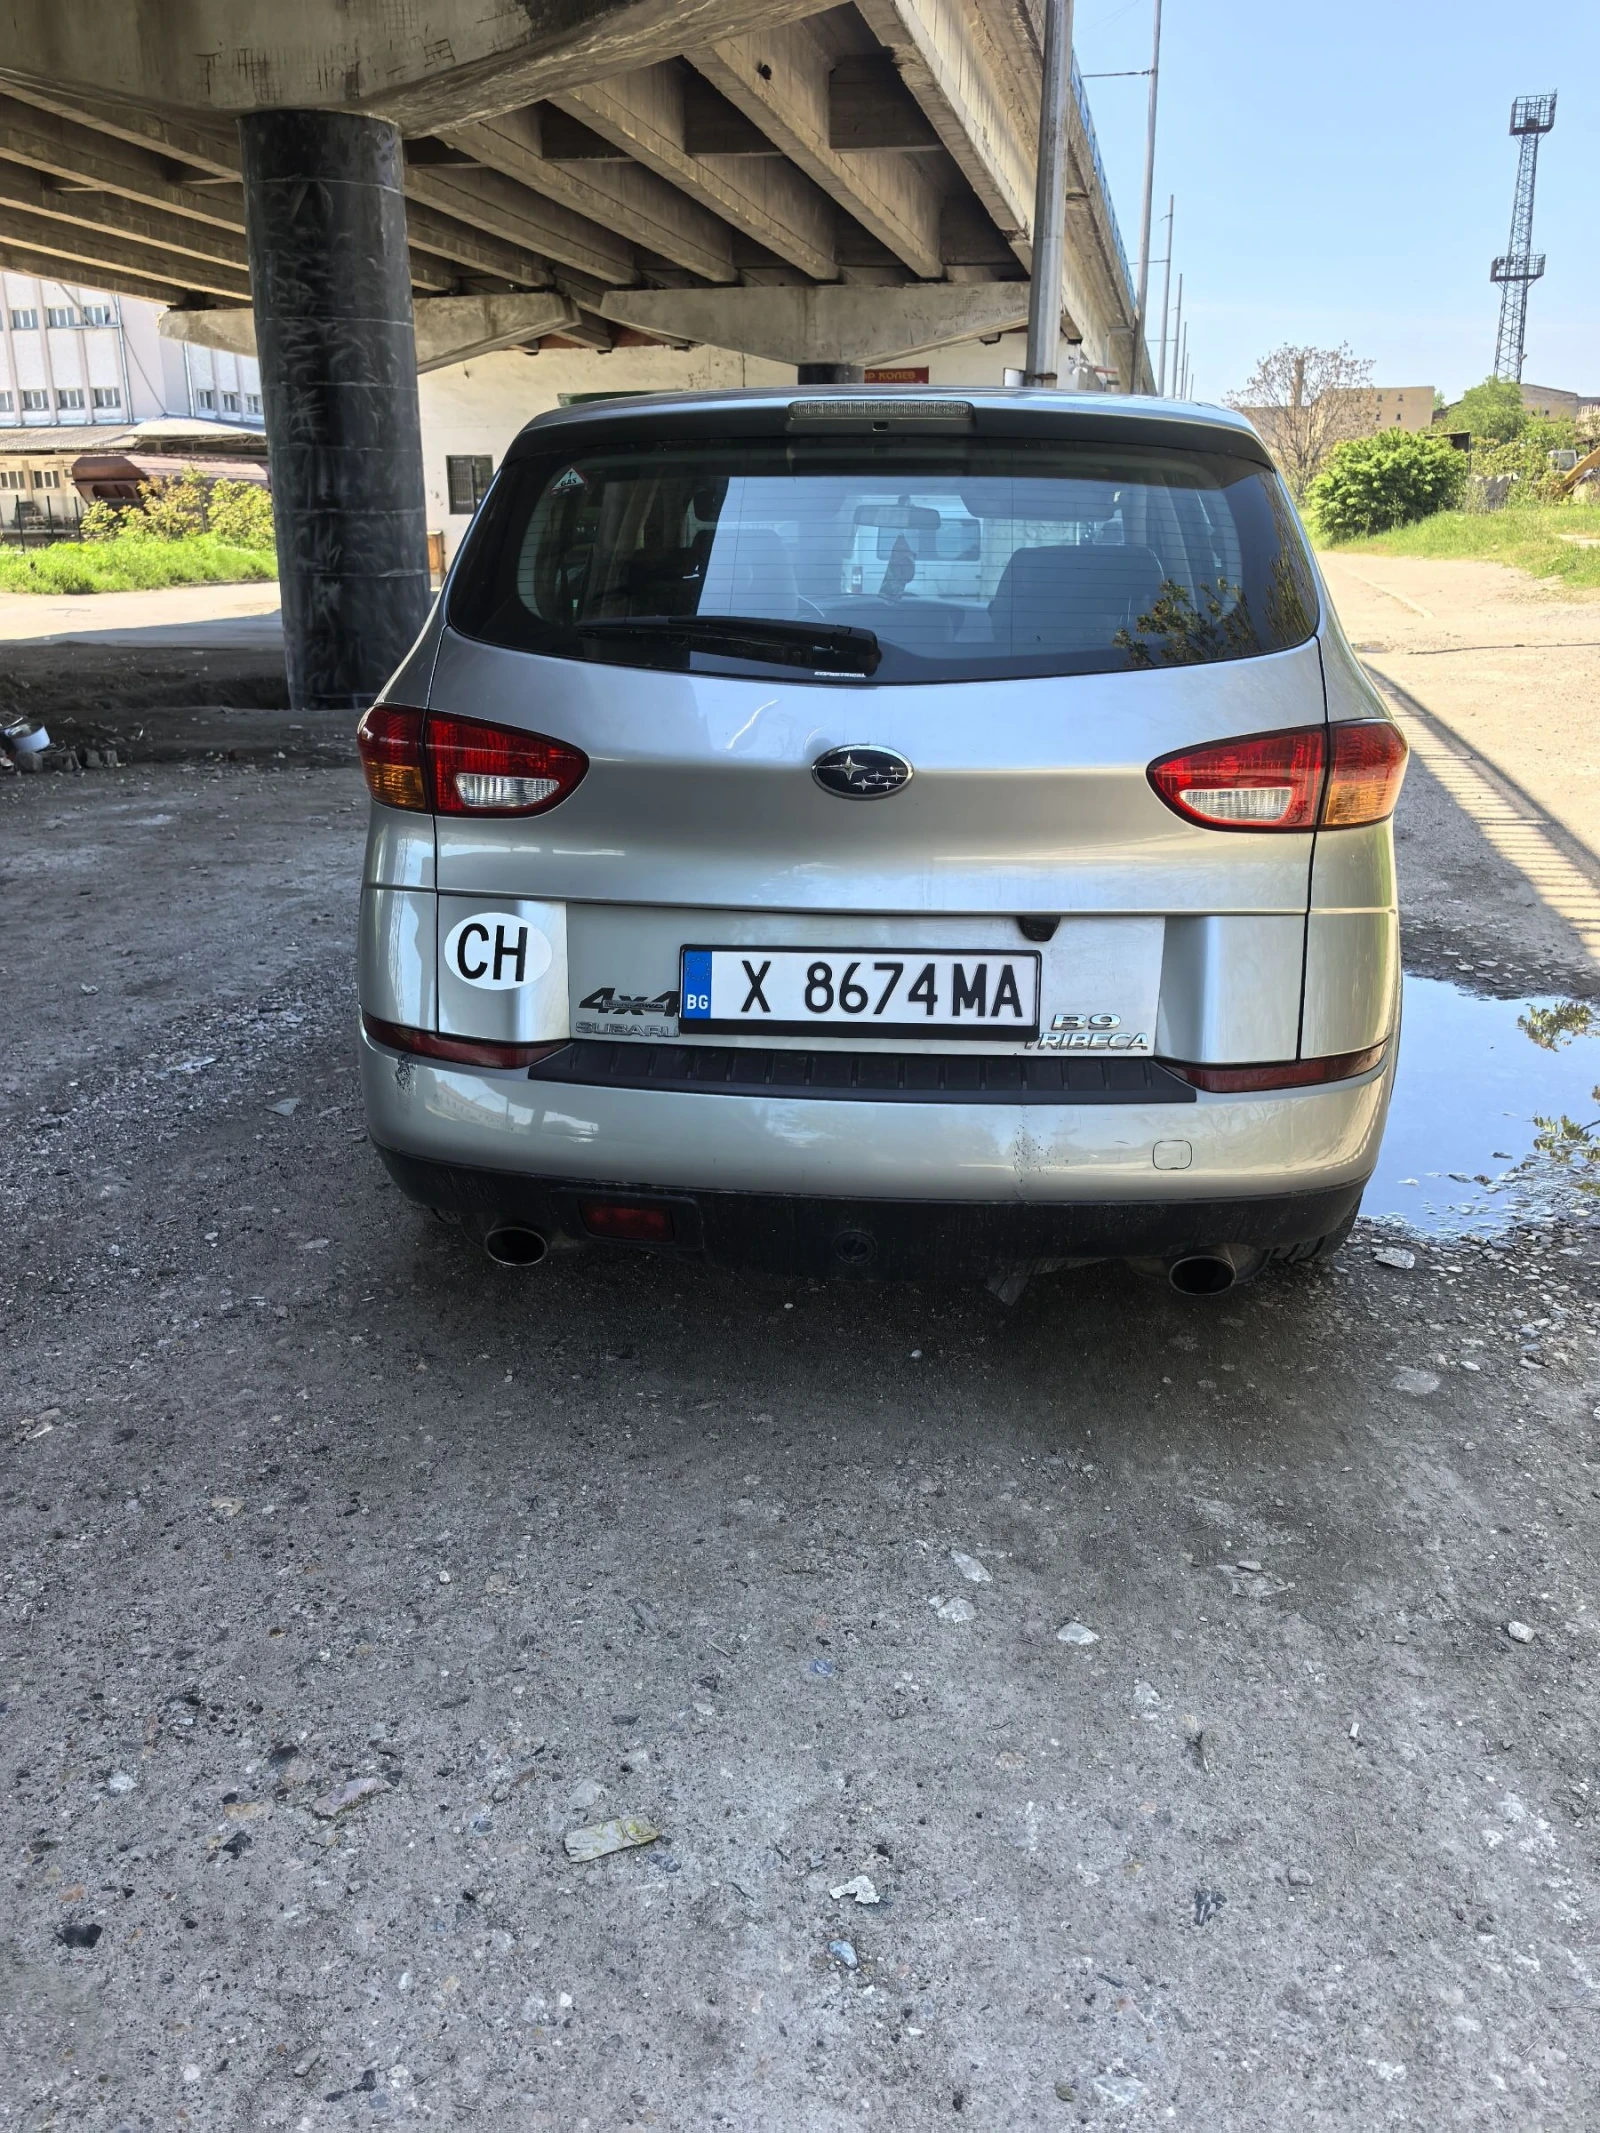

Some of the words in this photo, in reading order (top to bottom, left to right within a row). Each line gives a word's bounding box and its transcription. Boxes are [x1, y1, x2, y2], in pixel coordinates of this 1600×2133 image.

[560, 478, 577, 486] GAS
[457, 922, 528, 982] CH
[740, 960, 772, 1014] X
[804, 961, 939, 1016] 8674
[951, 963, 1024, 1018] MA
[686, 993, 709, 1010] BG
[575, 1021, 681, 1038] SUBARU
[1050, 1012, 1121, 1031] B9
